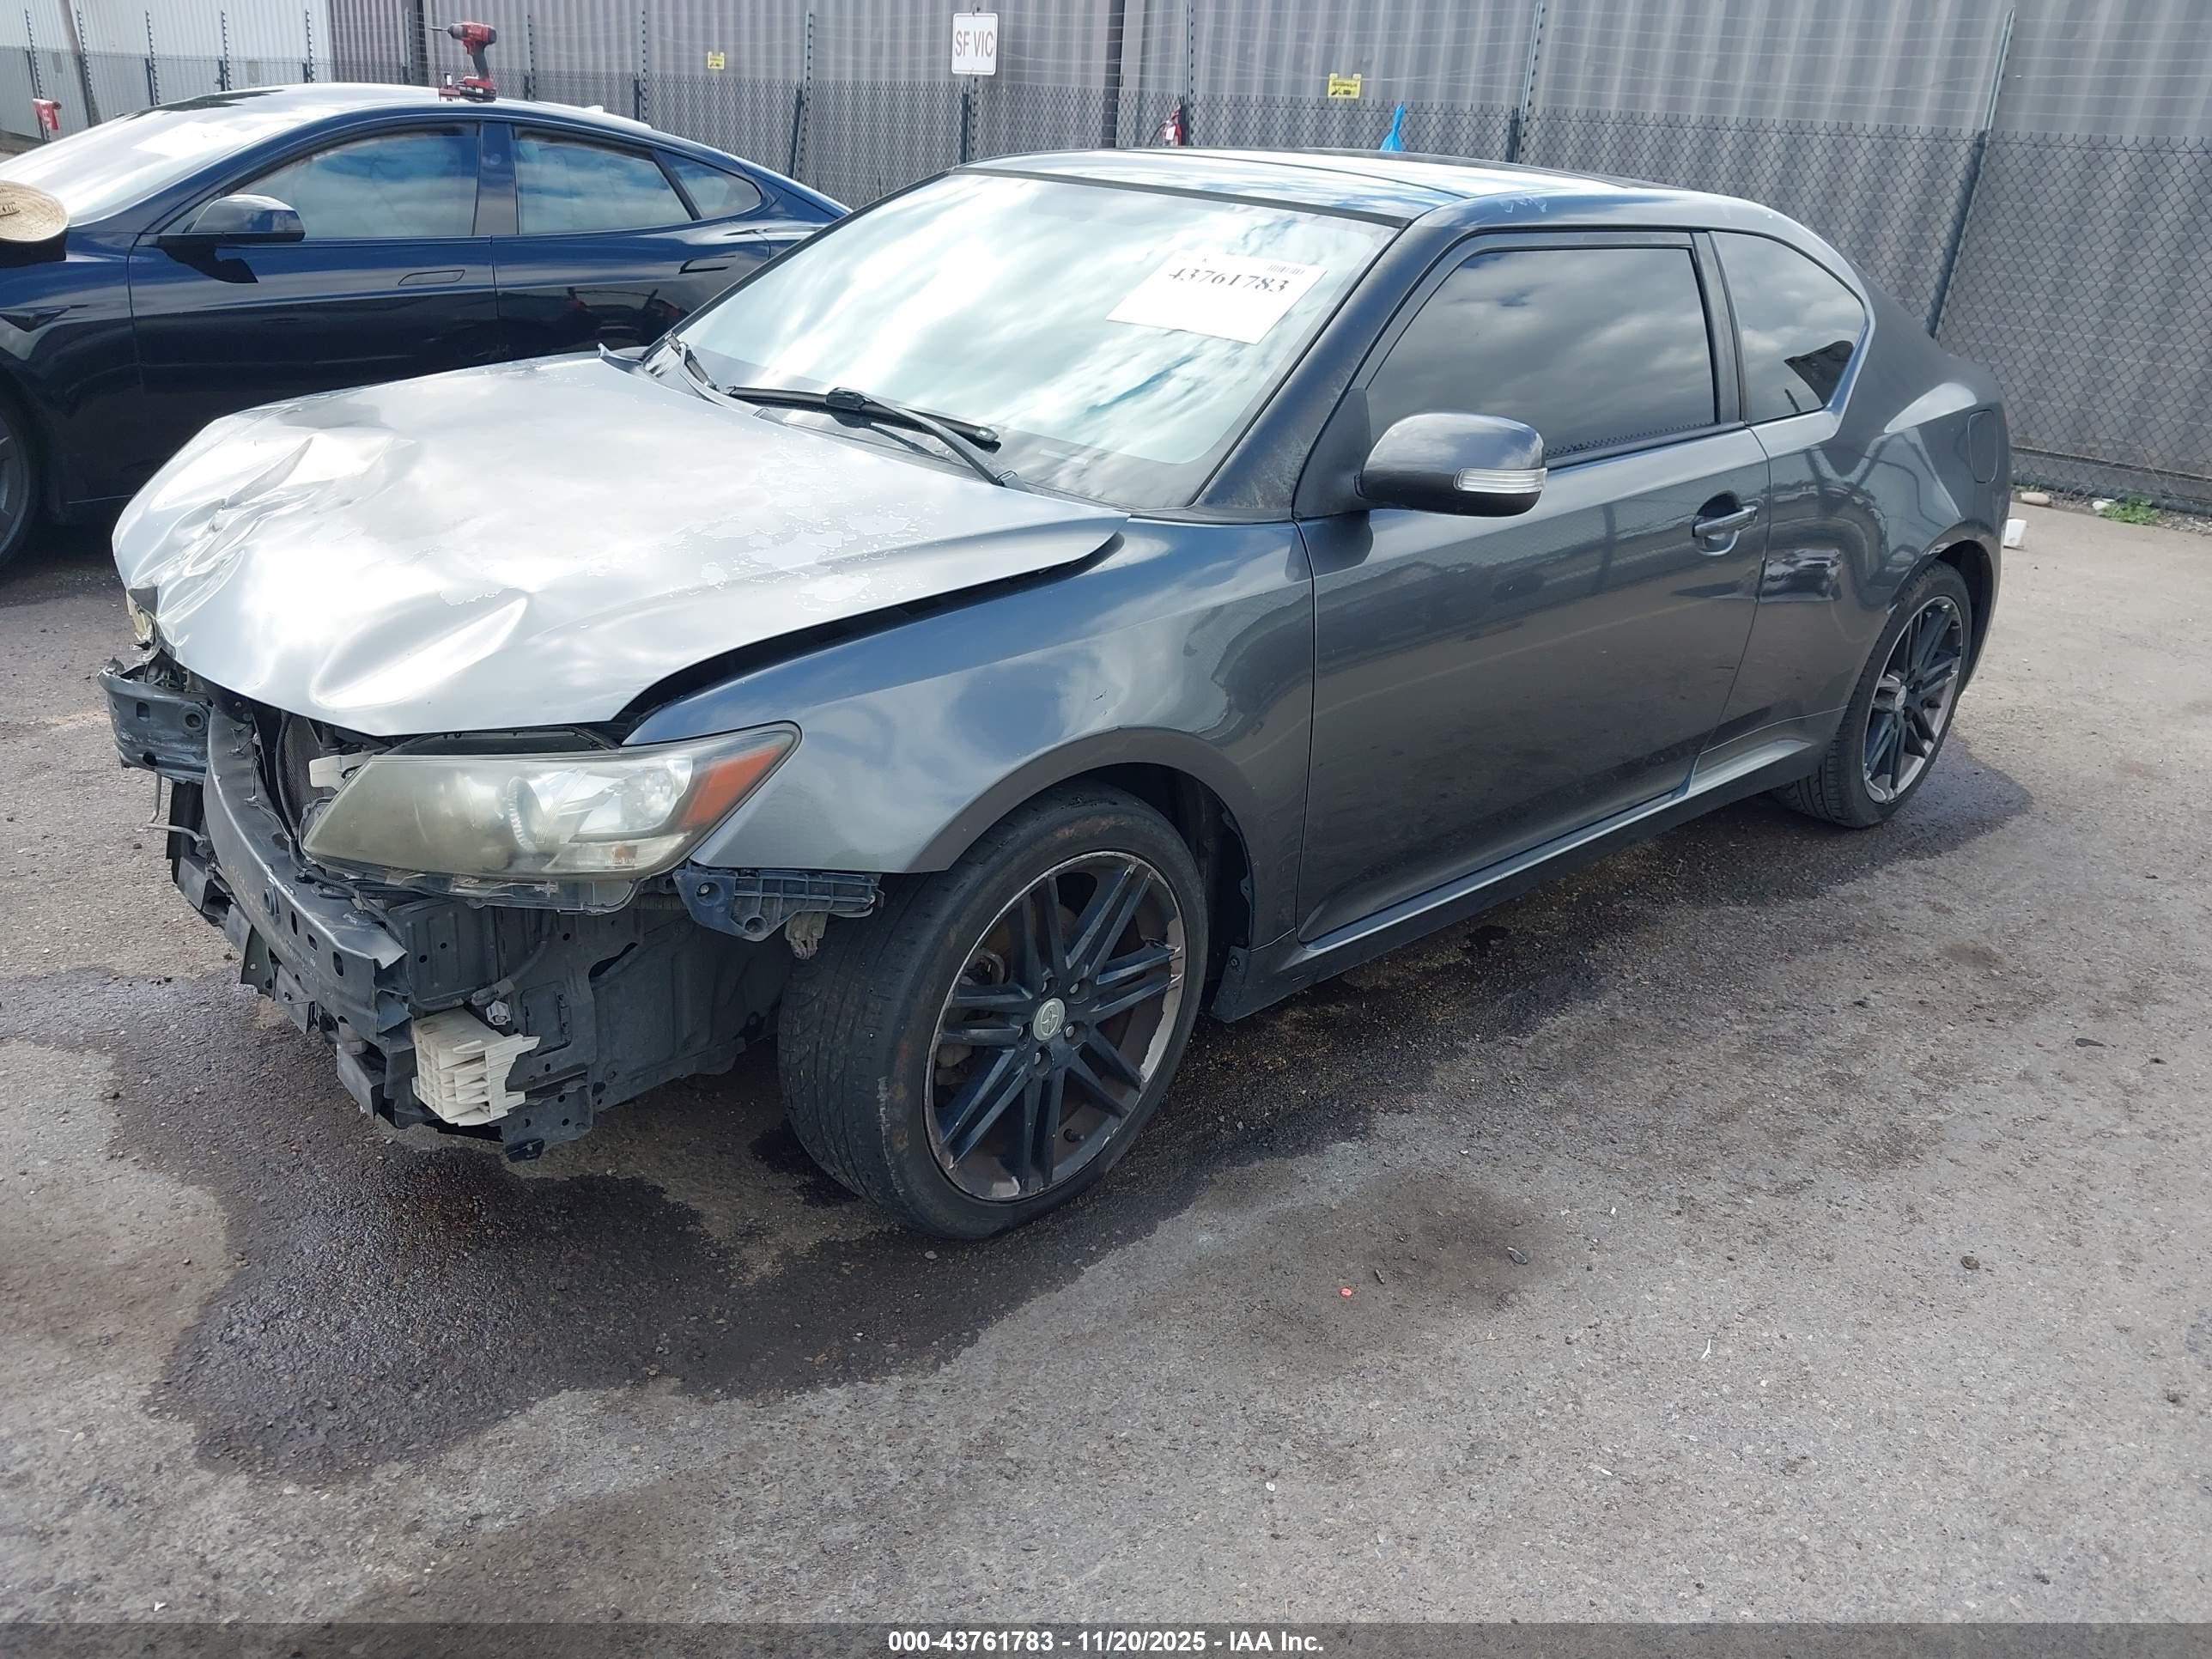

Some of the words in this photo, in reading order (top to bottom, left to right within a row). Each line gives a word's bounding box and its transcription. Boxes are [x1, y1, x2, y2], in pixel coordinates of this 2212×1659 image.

[955, 30, 970, 58] SF
[973, 30, 994, 58] VIC
[1169, 267, 1290, 293] 43761783
